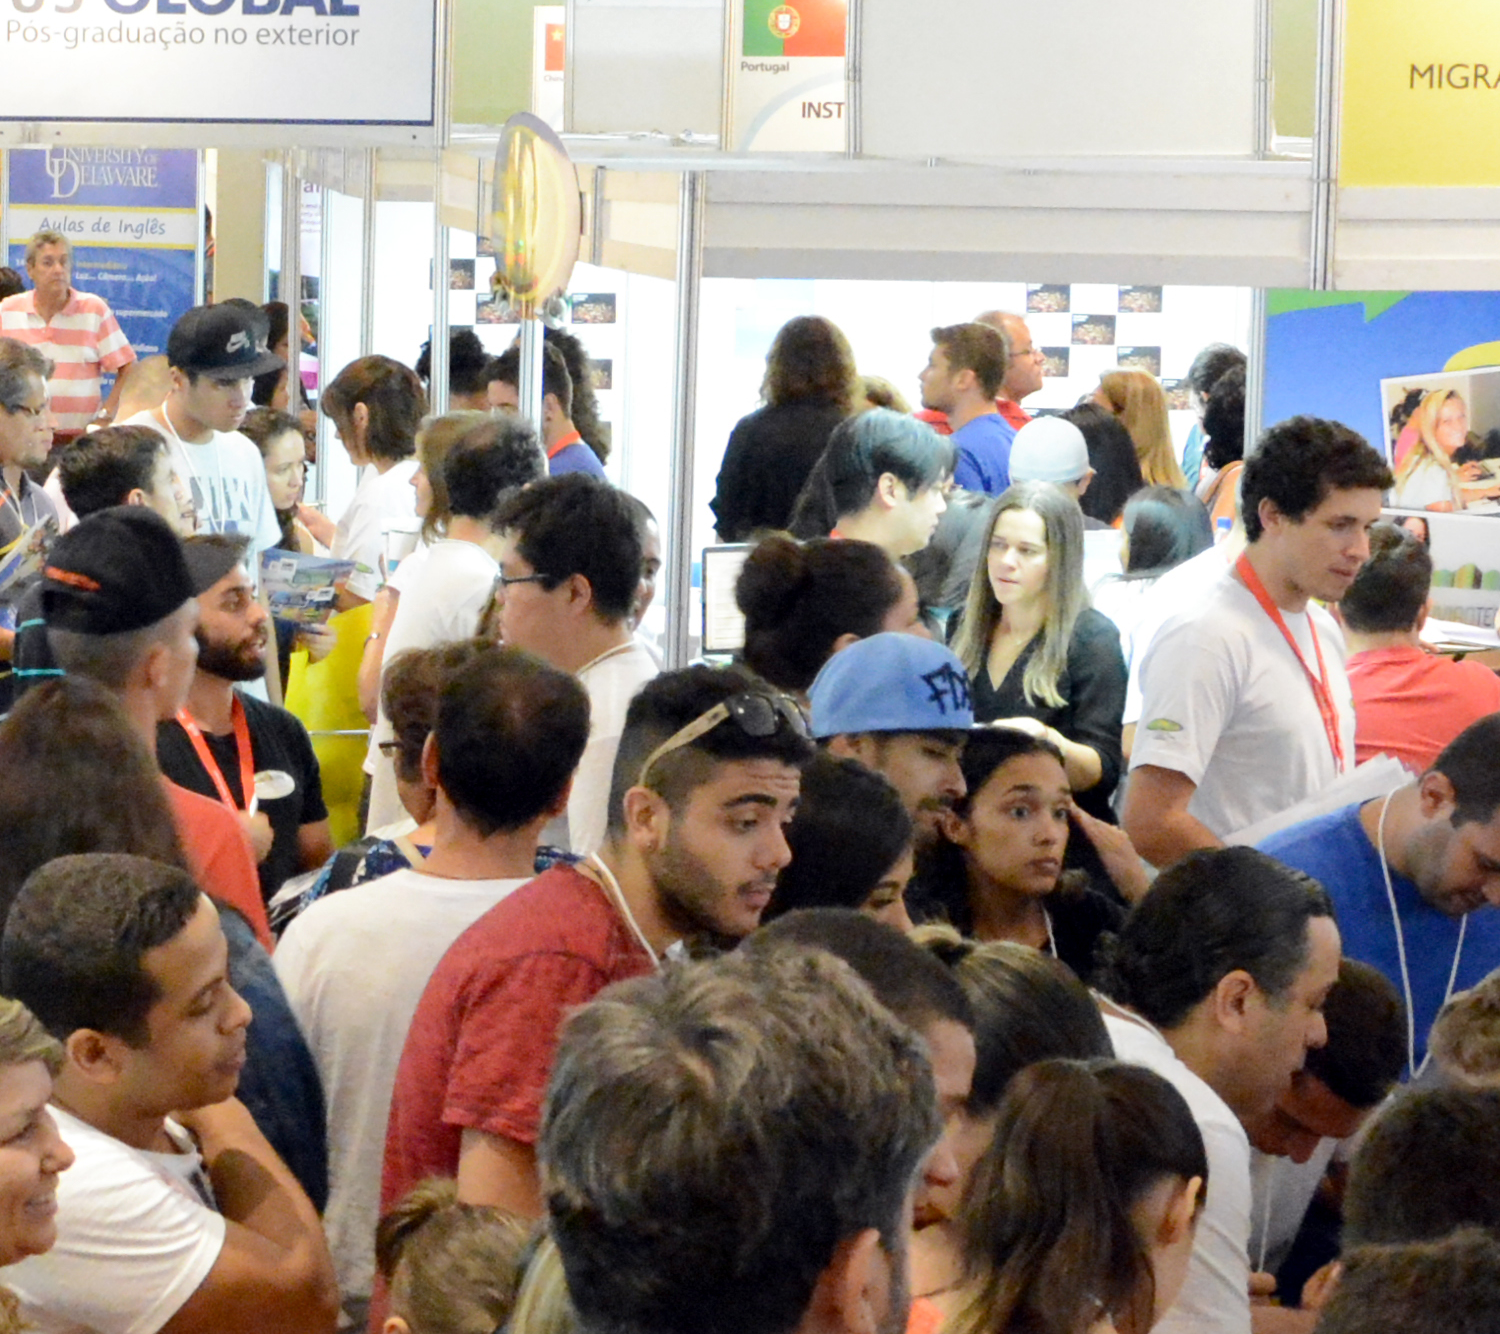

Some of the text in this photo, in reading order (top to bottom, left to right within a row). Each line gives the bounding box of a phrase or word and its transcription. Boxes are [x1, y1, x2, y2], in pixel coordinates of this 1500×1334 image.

[6, 18, 205, 50] Pós-graduação
[215, 27, 247, 46] no
[255, 20, 361, 47] exterior
[740, 61, 789, 75] Portugal
[802, 101, 845, 119] INST
[39, 216, 166, 238] Aulas de Inglês
